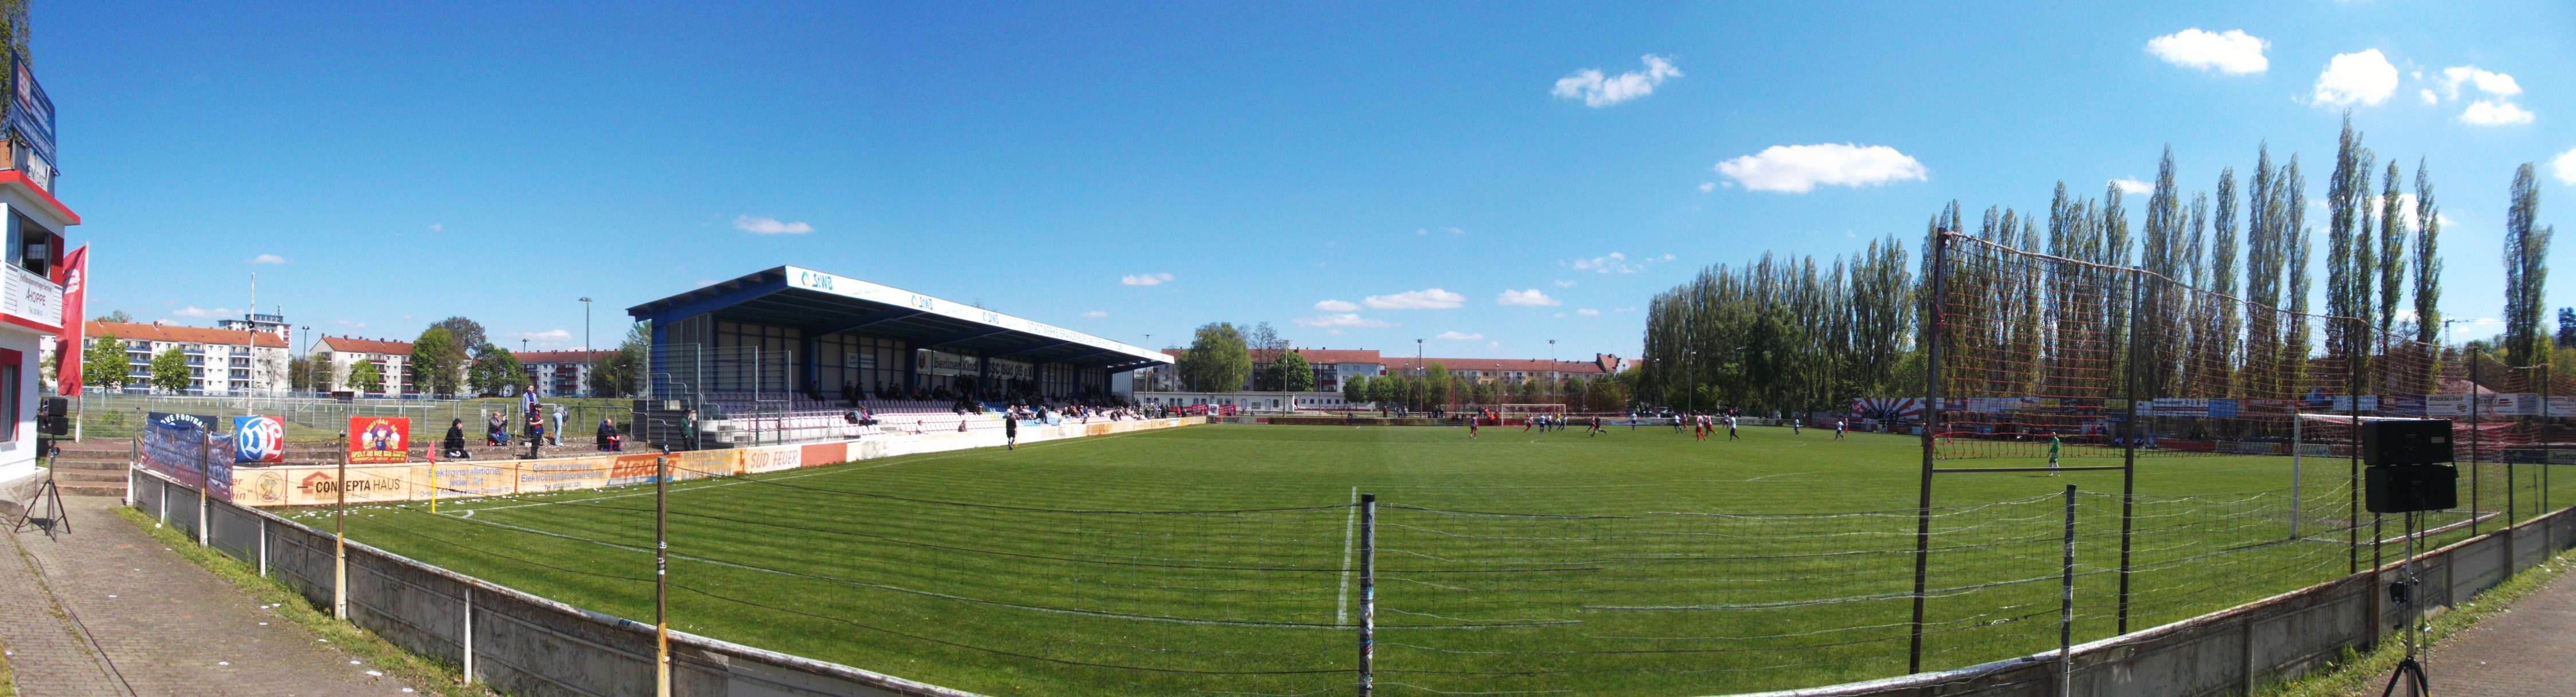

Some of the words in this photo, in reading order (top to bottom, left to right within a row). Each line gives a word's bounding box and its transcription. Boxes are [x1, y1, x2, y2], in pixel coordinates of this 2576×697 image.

[933, 356, 961, 370] Berliner
[962, 360, 979, 372] Kindl
[1002, 363, 1014, 376] Süd
[751, 450, 769, 468] SÜD
[773, 450, 799, 466] FEUER
[429, 467, 503, 477] Eektroinstallationen
[533, 464, 557, 472] Günther
[559, 463, 592, 471] Kohlmeyer
[450, 478, 469, 488] jeder
[473, 477, 484, 486] Art
[521, 471, 604, 483] Elektroinstallationsmeister
[316, 480, 371, 493] CONEPTA
[374, 479, 400, 491] HAUS
